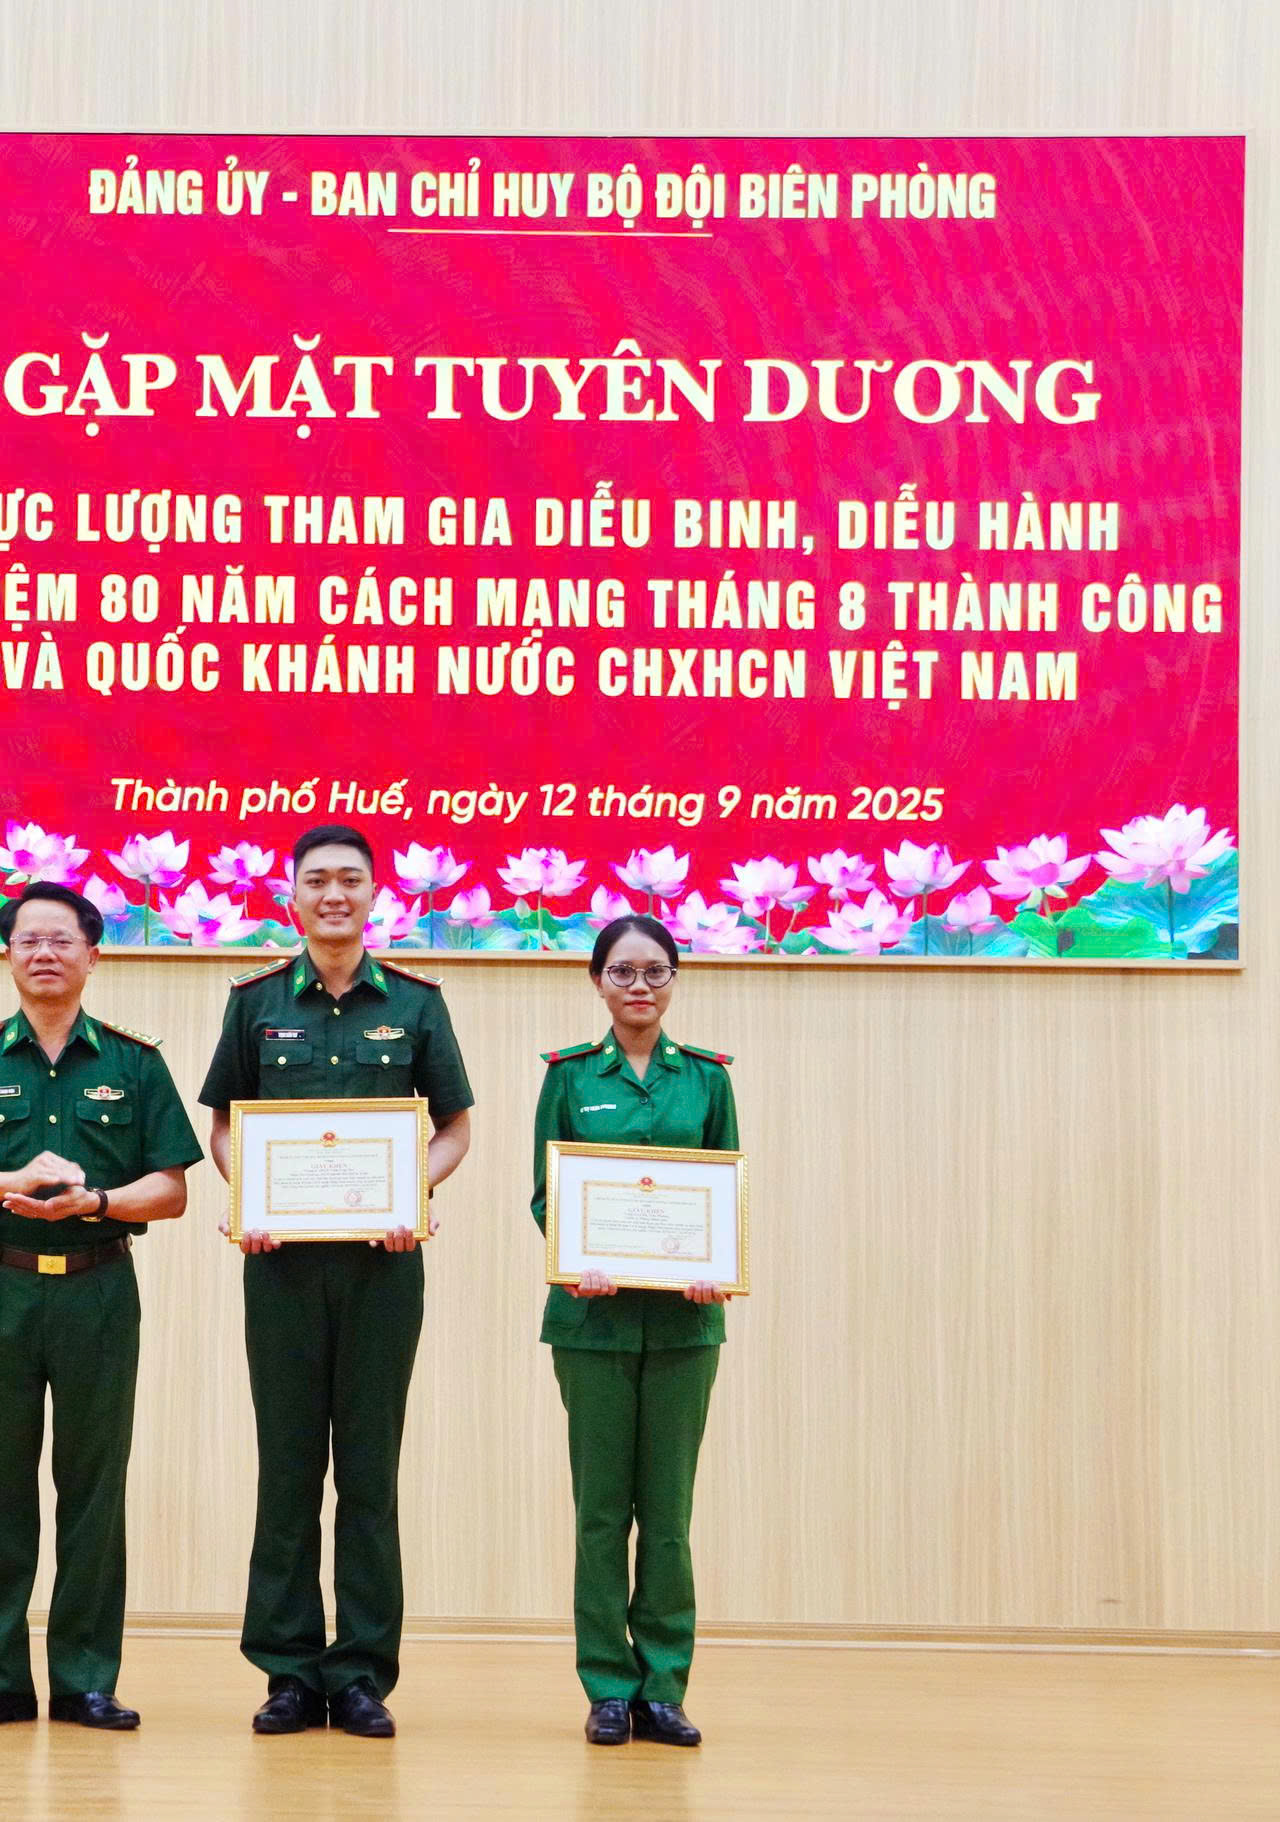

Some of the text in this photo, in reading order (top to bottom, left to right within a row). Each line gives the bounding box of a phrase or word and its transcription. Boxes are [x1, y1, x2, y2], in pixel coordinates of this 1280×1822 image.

[88, 155, 997, 229] ĐẢNG ỦY - BAN CHỈ HUY BỘ ĐỘI BIÊN PHÒNG
[3, 330, 1102, 440] GẶP MẶT TUYÊN DƯƠNG
[76, 488, 242, 553] LƯỢNG
[263, 495, 405, 545] THAM
[428, 496, 513, 546] GIA
[535, 480, 651, 548] DIỄU
[674, 499, 815, 556] BINH,
[838, 482, 956, 551] DIỄU
[978, 490, 1120, 552] HÀNH
[100, 573, 159, 623] 80
[181, 564, 296, 624] NĂM
[319, 566, 453, 626] CÁCH
[476, 577, 625, 638] MẠNG
[647, 569, 816, 631] THÁNG
[838, 581, 867, 631] 8
[887, 571, 1059, 632] THÀNH
[1081, 572, 1223, 634] CÔNG
[1, 624, 1078, 711] VÀ QUỐC KHÁNH NƯỚC CHXHCN VIỆT NAM
[111, 776, 945, 827] Thành phố Huế, ngày 12 tháng 9 năm 2025
